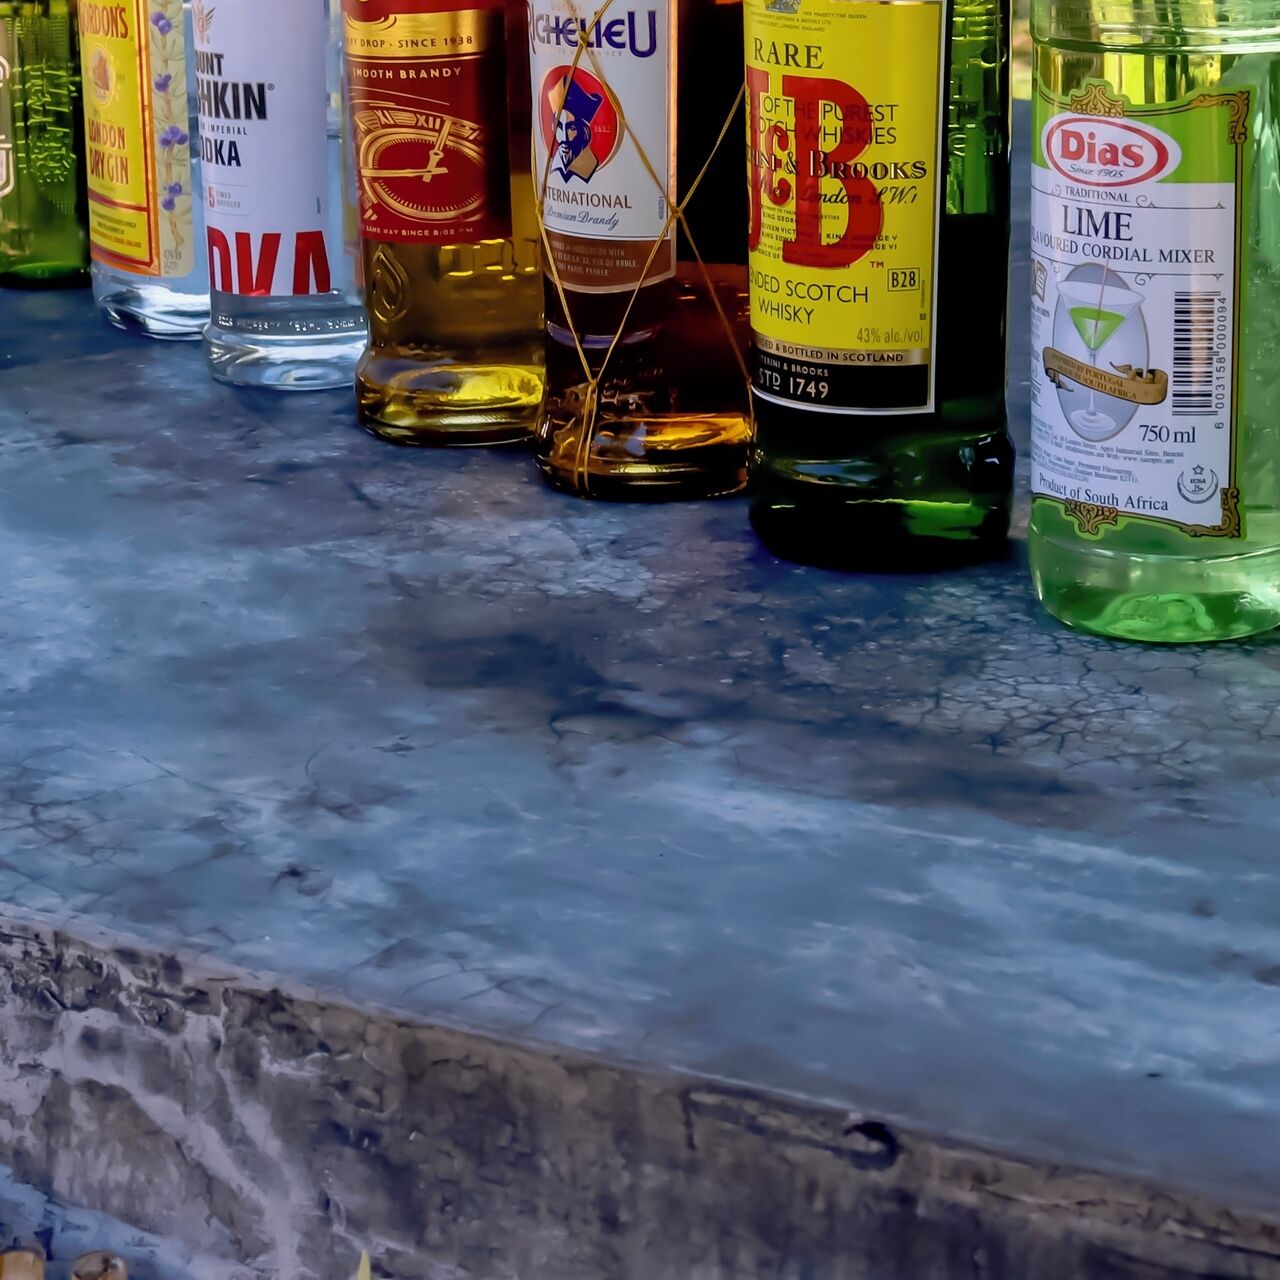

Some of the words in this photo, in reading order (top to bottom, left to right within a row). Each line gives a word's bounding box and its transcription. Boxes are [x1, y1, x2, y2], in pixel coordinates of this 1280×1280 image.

[360, 38, 386, 49] DROP
[398, 38, 437, 49] SINCE
[443, 35, 473, 47] 1938
[754, 37, 824, 70] RARE
[400, 66, 462, 79] BRANDY
[88, 117, 126, 150] LONDON
[1060, 128, 1145, 169] Dias
[89, 144, 105, 182] DRY
[106, 153, 129, 185] GIN
[809, 150, 927, 180] BROOKS
[1065, 186, 1131, 202] TRADITIONAL
[1062, 204, 1134, 242] LIME
[1082, 243, 1153, 263] CORDIAL
[1159, 248, 1216, 264] MIXER
[891, 271, 917, 288] B28
[785, 280, 869, 304] SCOTCH
[758, 296, 815, 325] WHISKY
[857, 327, 881, 344] 43%
[1216, 297, 1227, 350] 000094
[782, 344, 823, 360] BOTTLED
[827, 352, 839, 362] IN
[843, 353, 904, 363] SCOTLAND
[791, 363, 829, 377] BROOKS
[789, 376, 829, 400] 1749
[1214, 356, 1226, 410] 003158
[1139, 424, 1170, 443] 750
[1173, 426, 1197, 443] ml
[1039, 472, 1068, 497] Product
[1070, 487, 1082, 499] of
[1084, 488, 1120, 507] South
[1124, 495, 1169, 511] Africa
